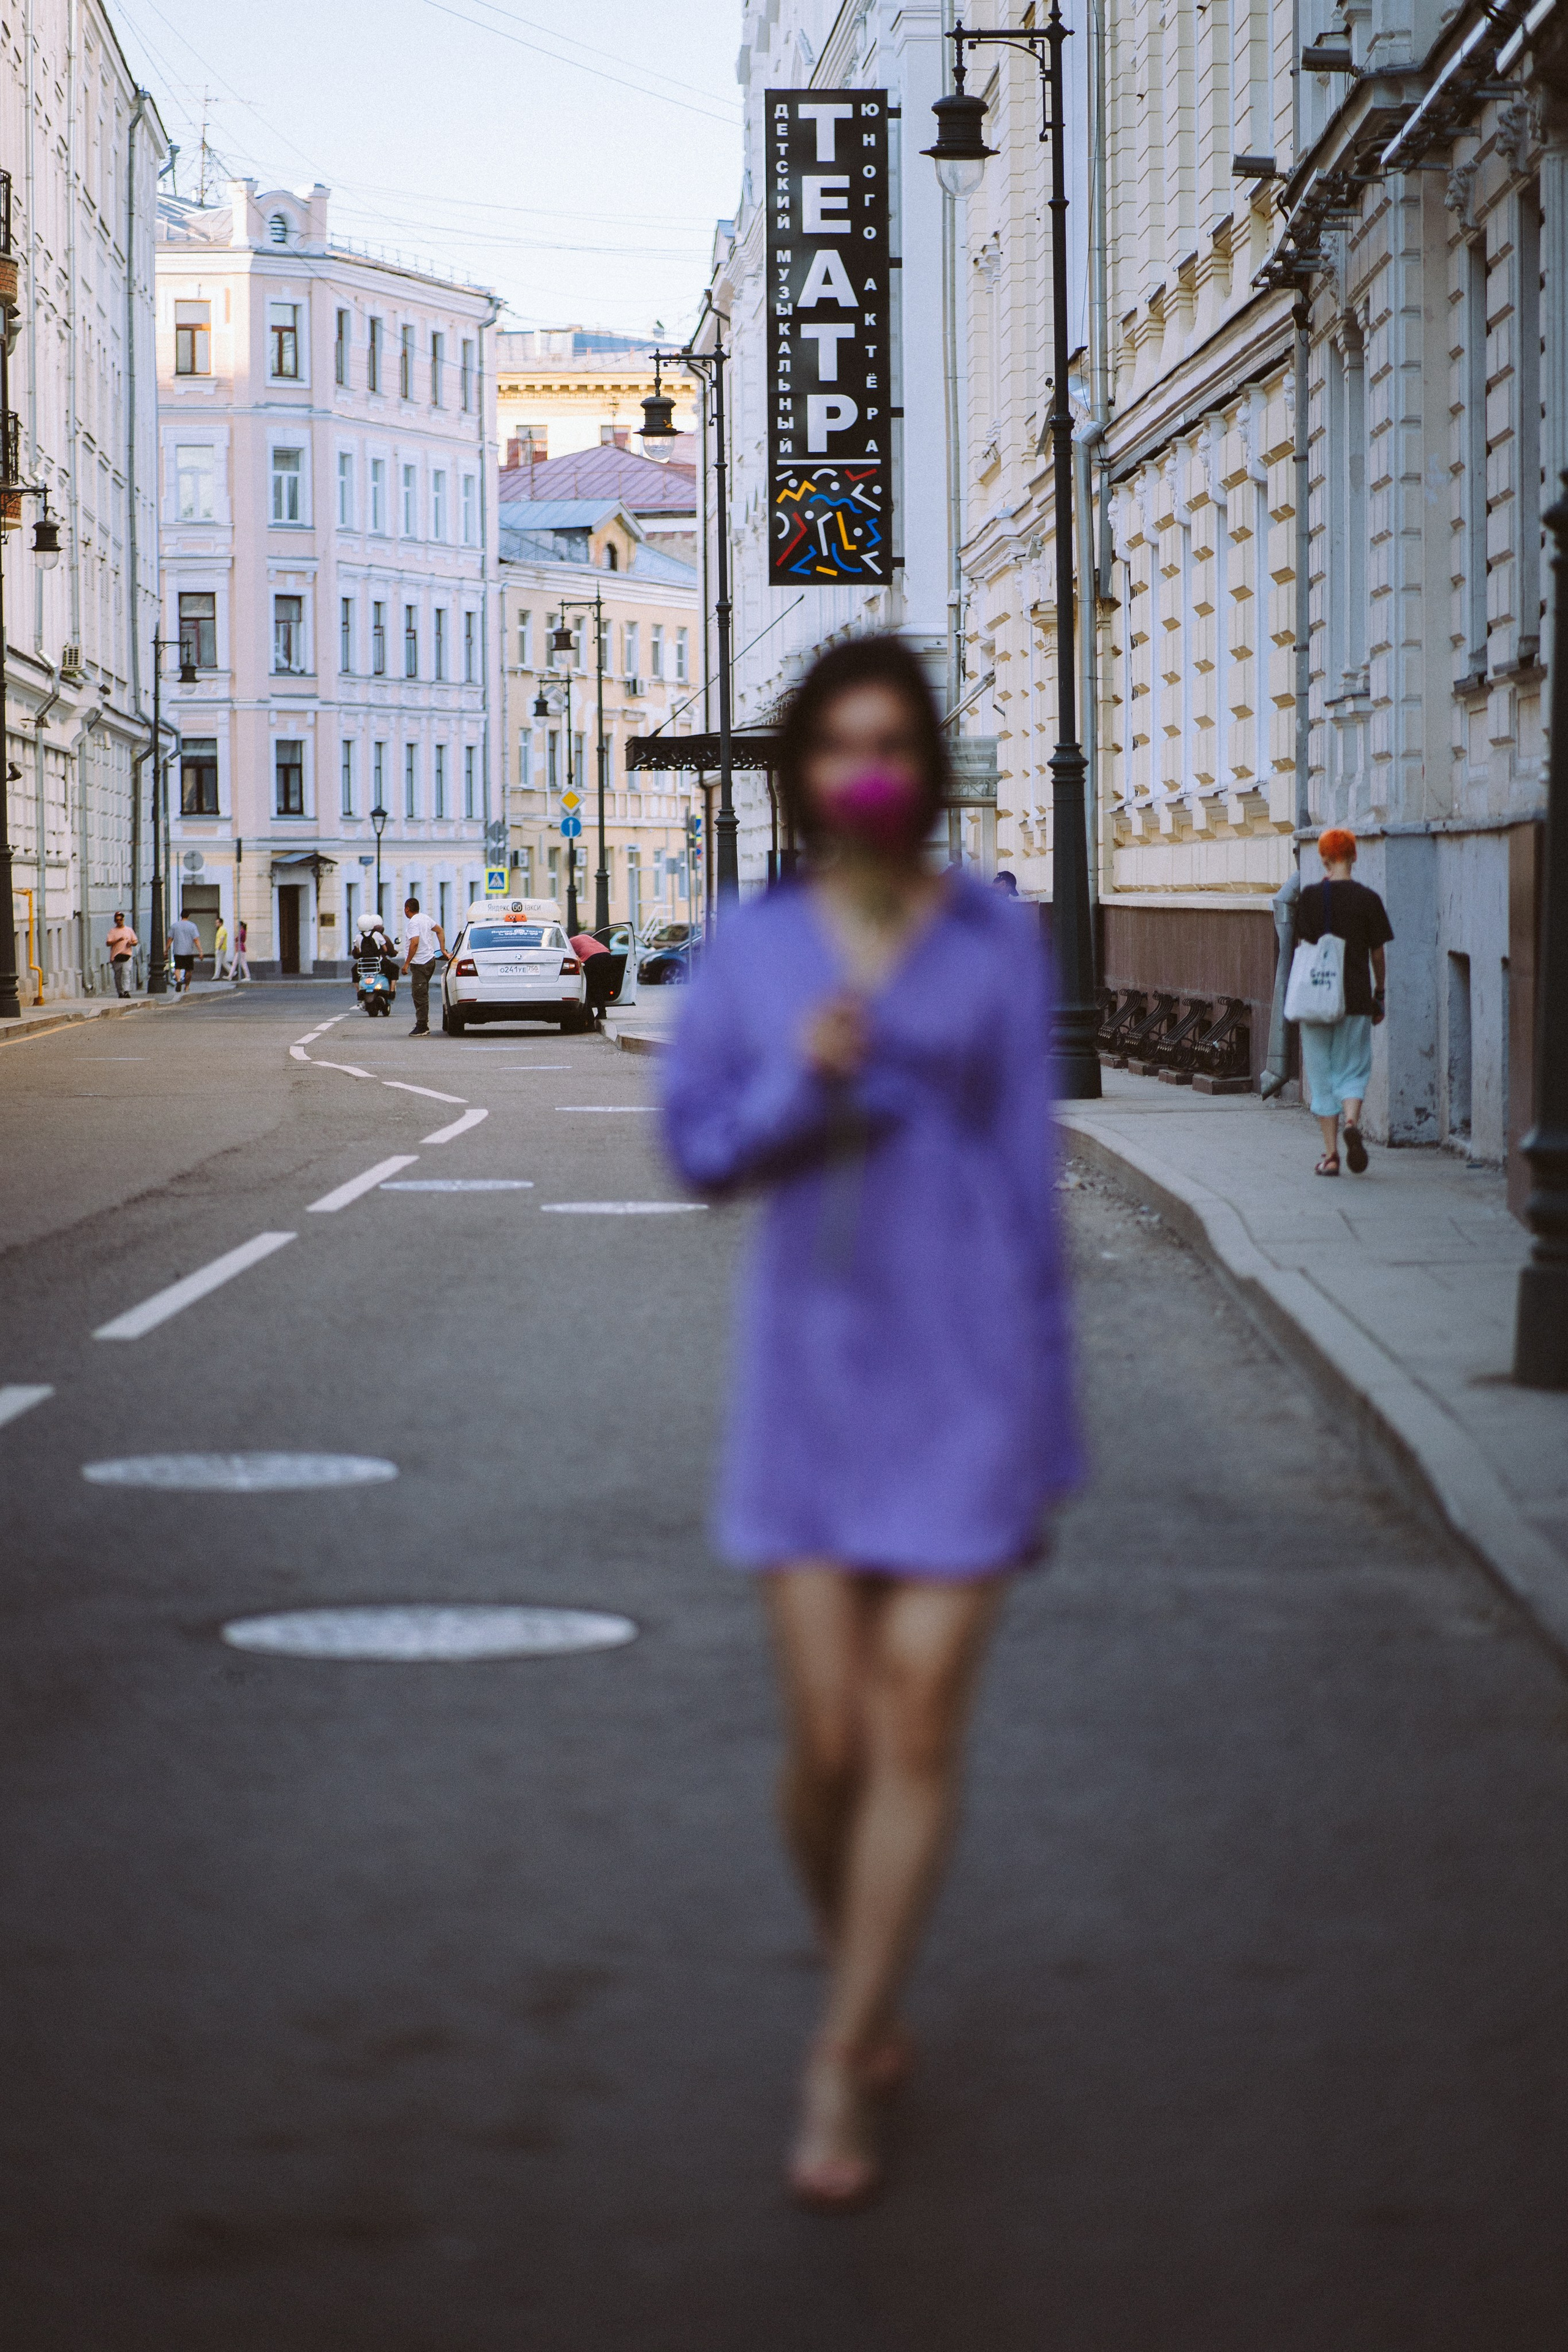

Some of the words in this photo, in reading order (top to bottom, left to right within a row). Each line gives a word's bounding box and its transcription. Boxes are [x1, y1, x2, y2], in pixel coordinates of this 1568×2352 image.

[774, 104, 791, 229] ДЕТСКИЙ
[861, 103, 880, 239] ЮНОГО
[776, 250, 794, 453] МУЗЫКАЛЬНЫЙ
[796, 104, 859, 453] ТЕАТР
[864, 277, 879, 452] АКТЁРА
[488, 903, 510, 912] Яндекс
[512, 902, 522, 912] Go
